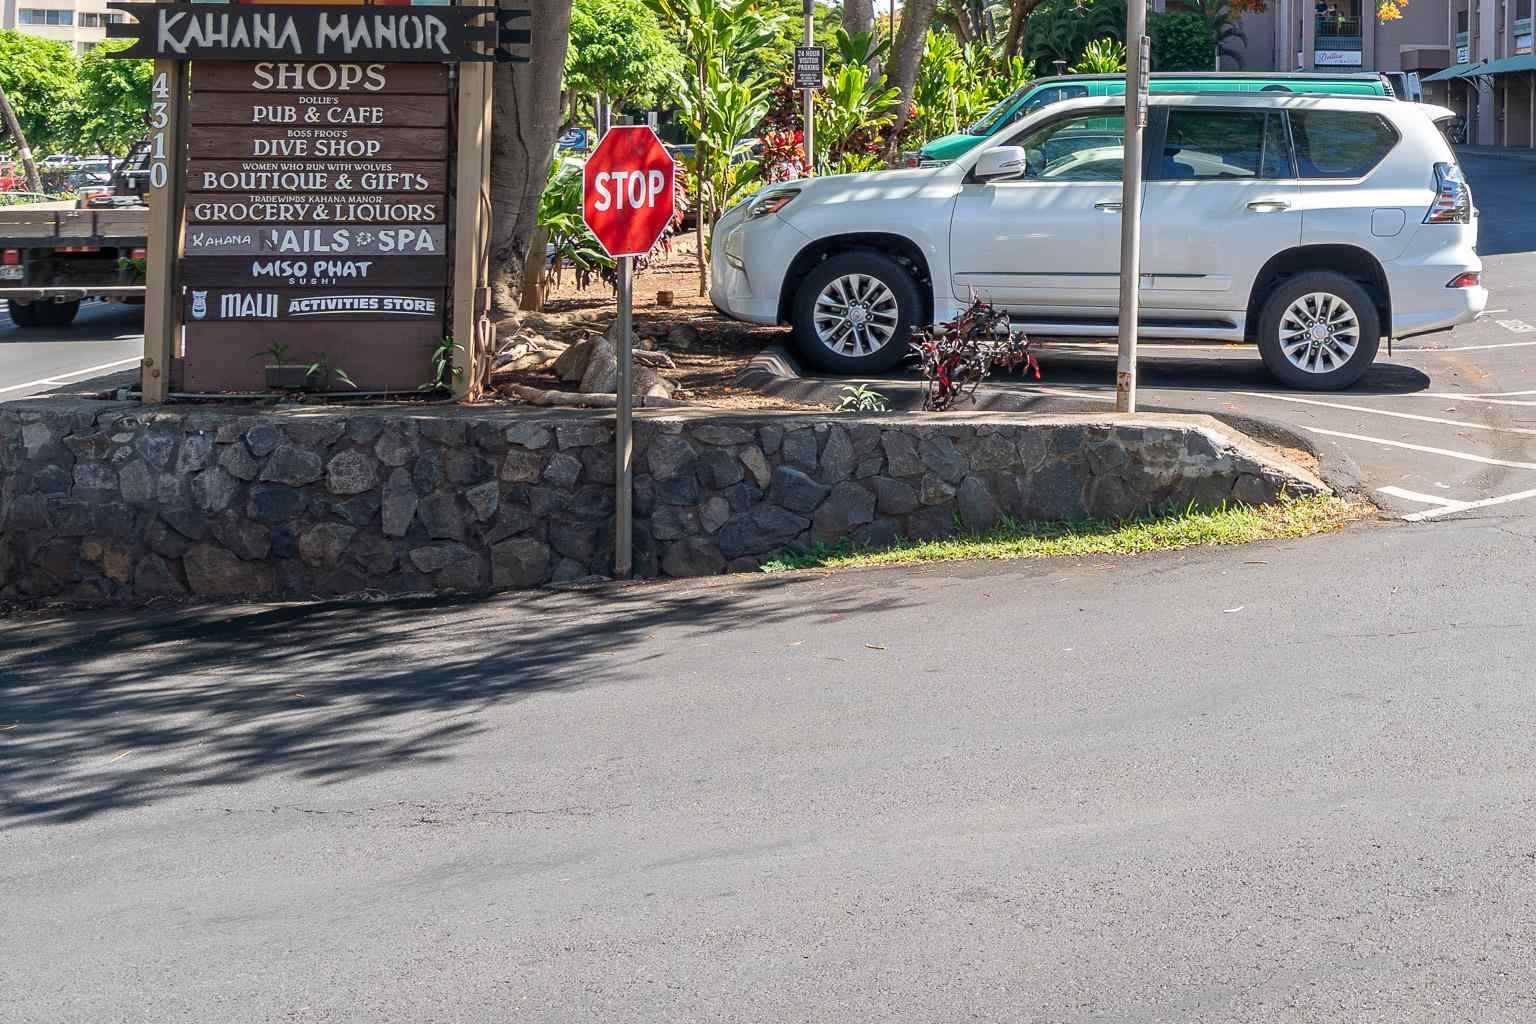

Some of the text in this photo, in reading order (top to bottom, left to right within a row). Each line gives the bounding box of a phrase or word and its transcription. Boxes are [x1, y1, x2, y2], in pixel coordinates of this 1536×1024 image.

[158, 9, 450, 54] KAHANA MANOR
[252, 62, 386, 91] SHOPS
[299, 96, 339, 105] DOLLIE'S
[252, 106, 384, 124] PUB & CAFE
[287, 129, 348, 138] BOSS FROG'S
[253, 139, 381, 157] DIVE SHOP
[242, 163, 392, 172] WOMEN WHO RUN WITH WOLVES
[203, 172, 430, 191] BOUTIQUE & GIFTS
[249, 195, 383, 203] TRADEWINDS KAHANA MANOR
[594, 170, 665, 212] STOP
[194, 203, 437, 222] GROCERY & LIQUORS
[192, 232, 251, 247] KAHANA
[378, 229, 436, 252] SPA
[252, 261, 373, 278] MISO PHAT
[220, 293, 436, 318] MAUI ACTIVITIES STORE
